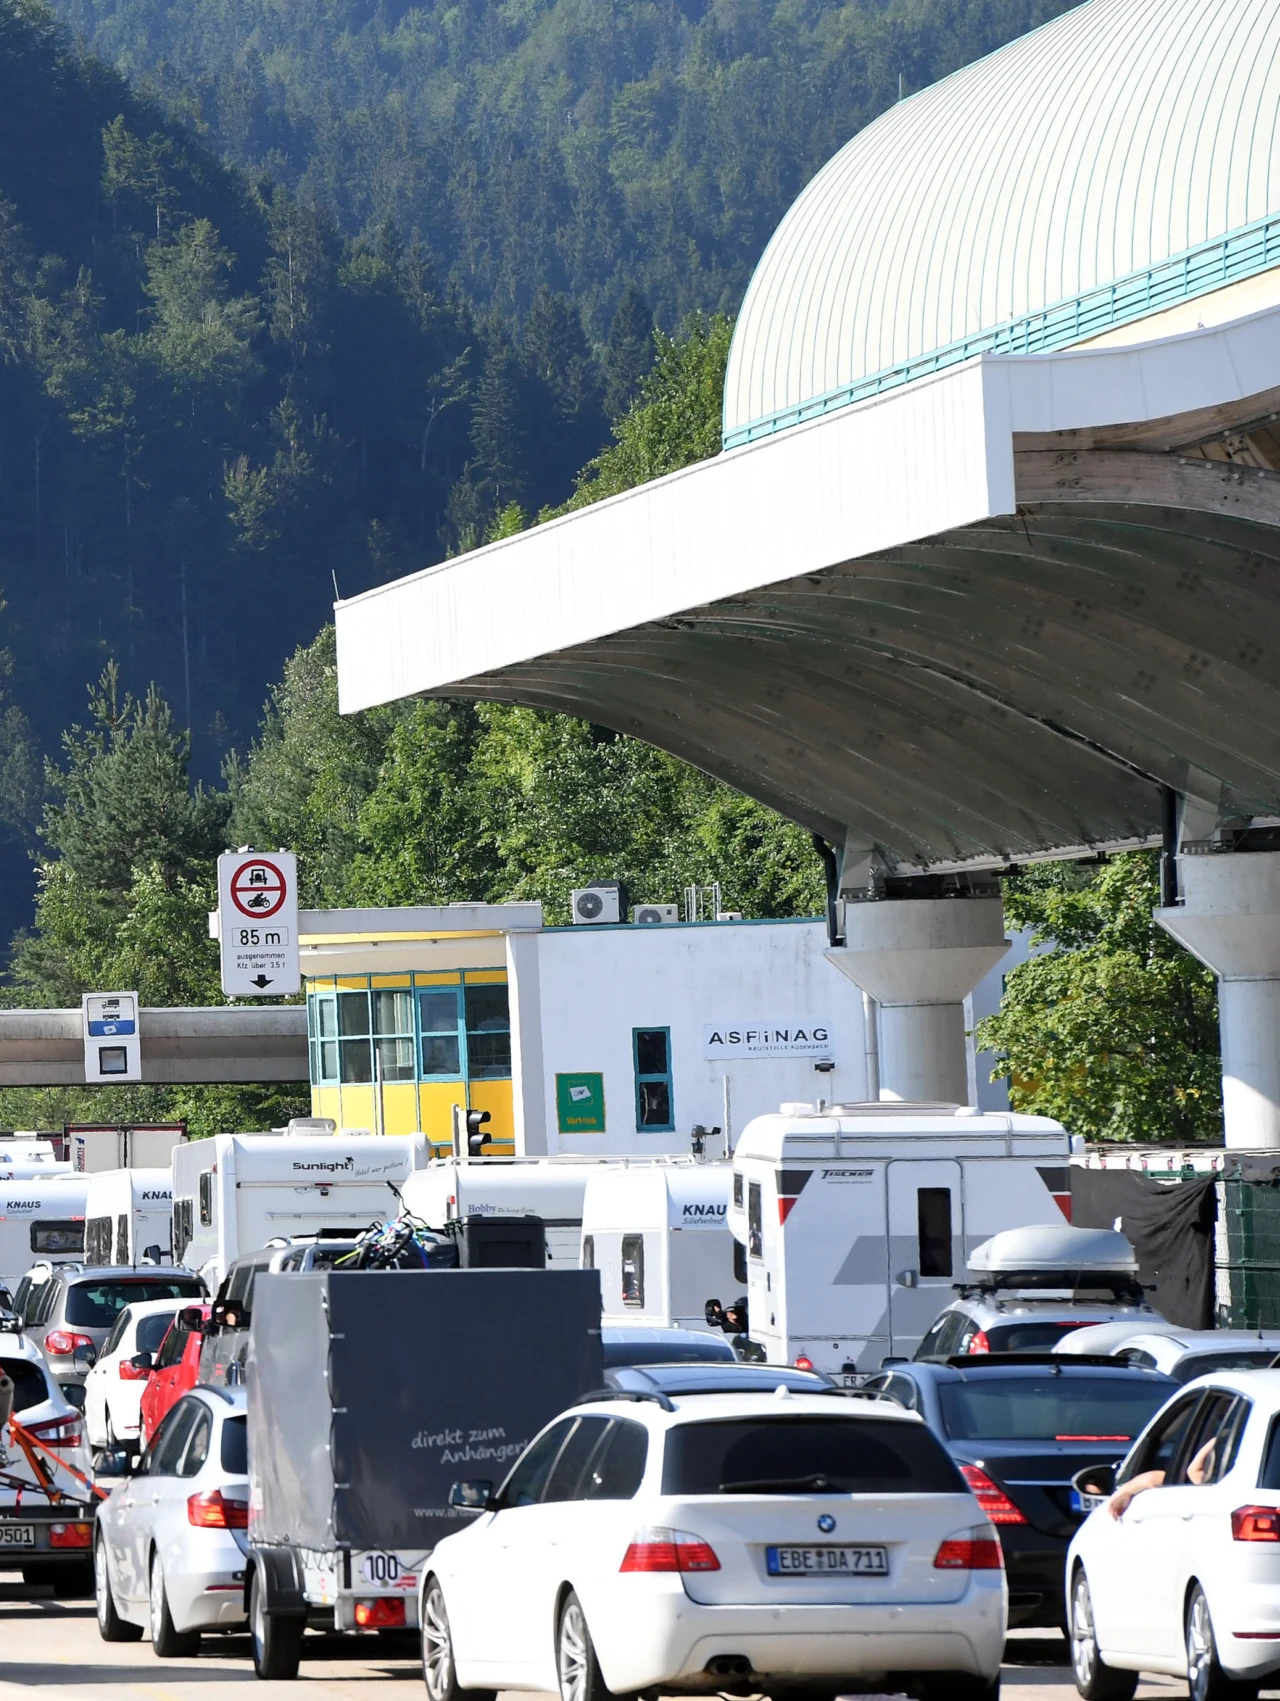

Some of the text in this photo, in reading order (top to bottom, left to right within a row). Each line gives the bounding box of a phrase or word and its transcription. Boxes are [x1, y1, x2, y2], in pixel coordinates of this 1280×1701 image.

[240, 929, 281, 945] 85 m
[236, 953, 286, 961] ausgenommen
[292, 1162, 350, 1172] Sunlight
[354, 1166, 370, 1177] Hotel
[6, 1201, 42, 1209] KNAUS
[468, 1204, 497, 1215] Hobby
[682, 1217, 725, 1225] Südwind
[411, 1427, 507, 1449] direkt zum
[780, 1550, 885, 1569] EBE DA 711
[366, 1554, 398, 1581] 100
